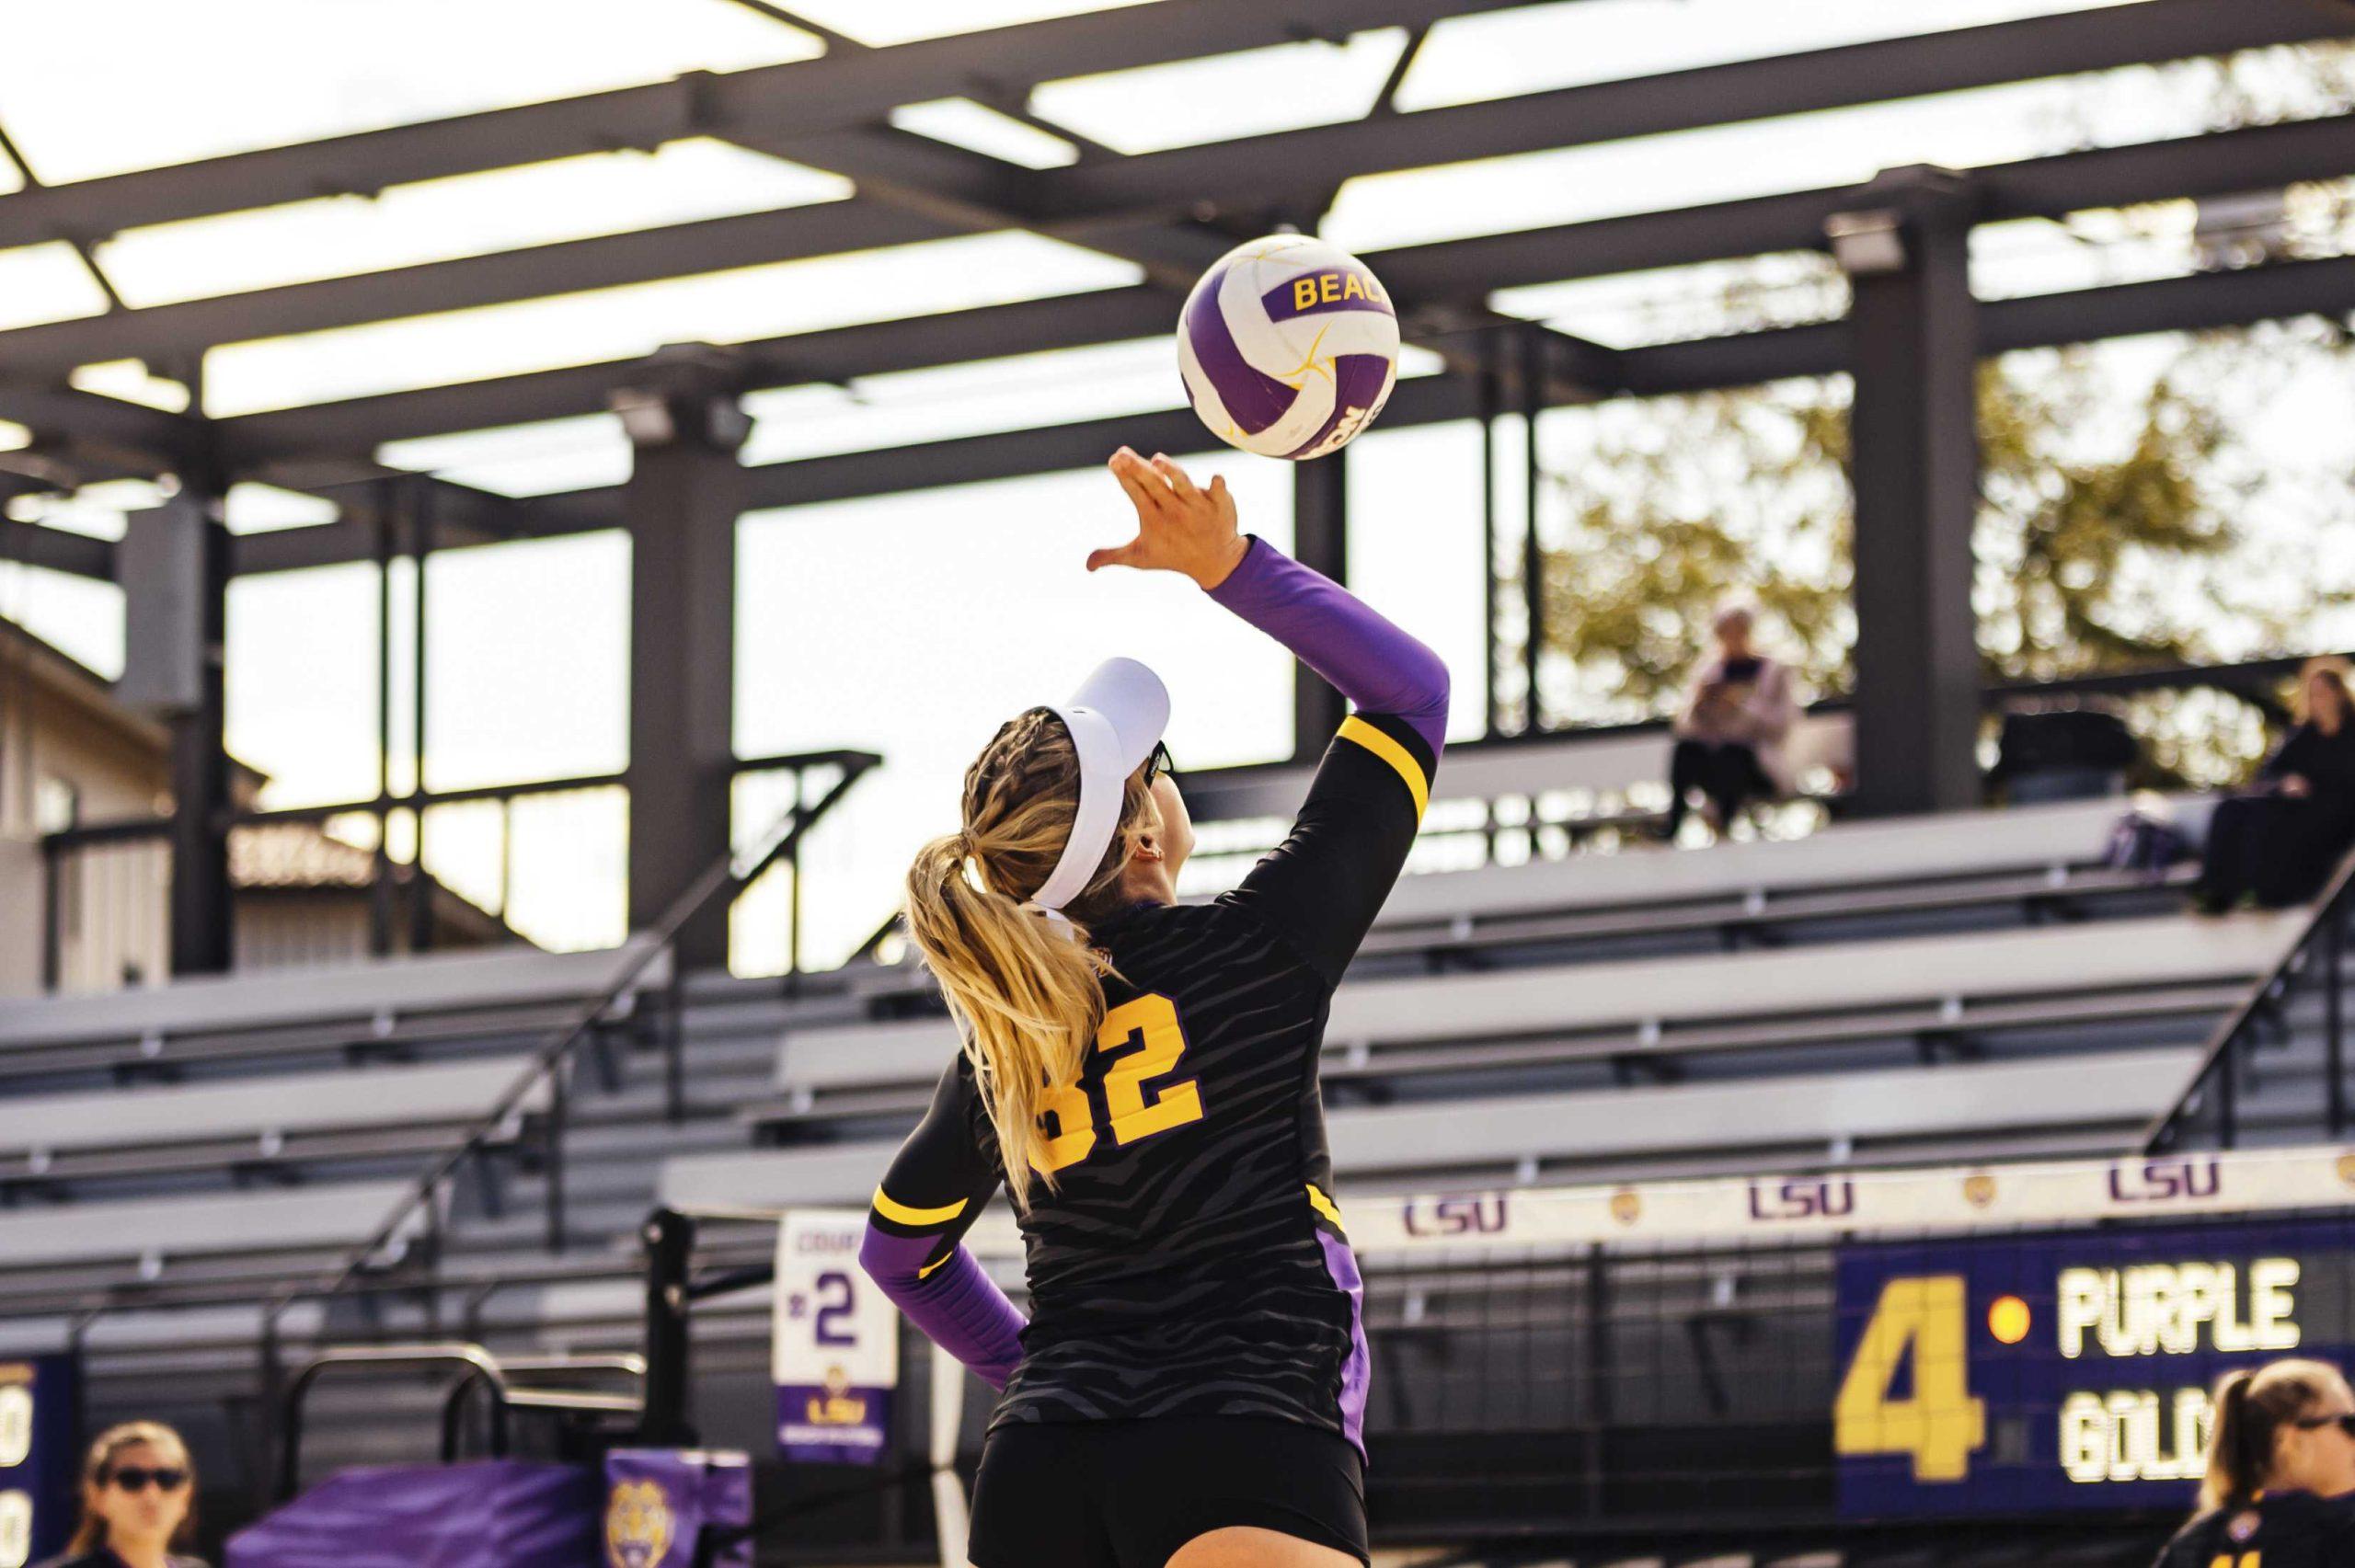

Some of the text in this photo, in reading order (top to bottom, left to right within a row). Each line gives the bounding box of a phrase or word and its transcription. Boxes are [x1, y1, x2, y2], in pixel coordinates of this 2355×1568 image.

[1294, 272, 1383, 311] BEAC
[1750, 1174, 1855, 1221] LSU
[2110, 1162, 2221, 1202] LSU
[1404, 1195, 1506, 1235] LSU
[2058, 1258, 2300, 1358] PURPLE
[1833, 1275, 1985, 1482] 4
